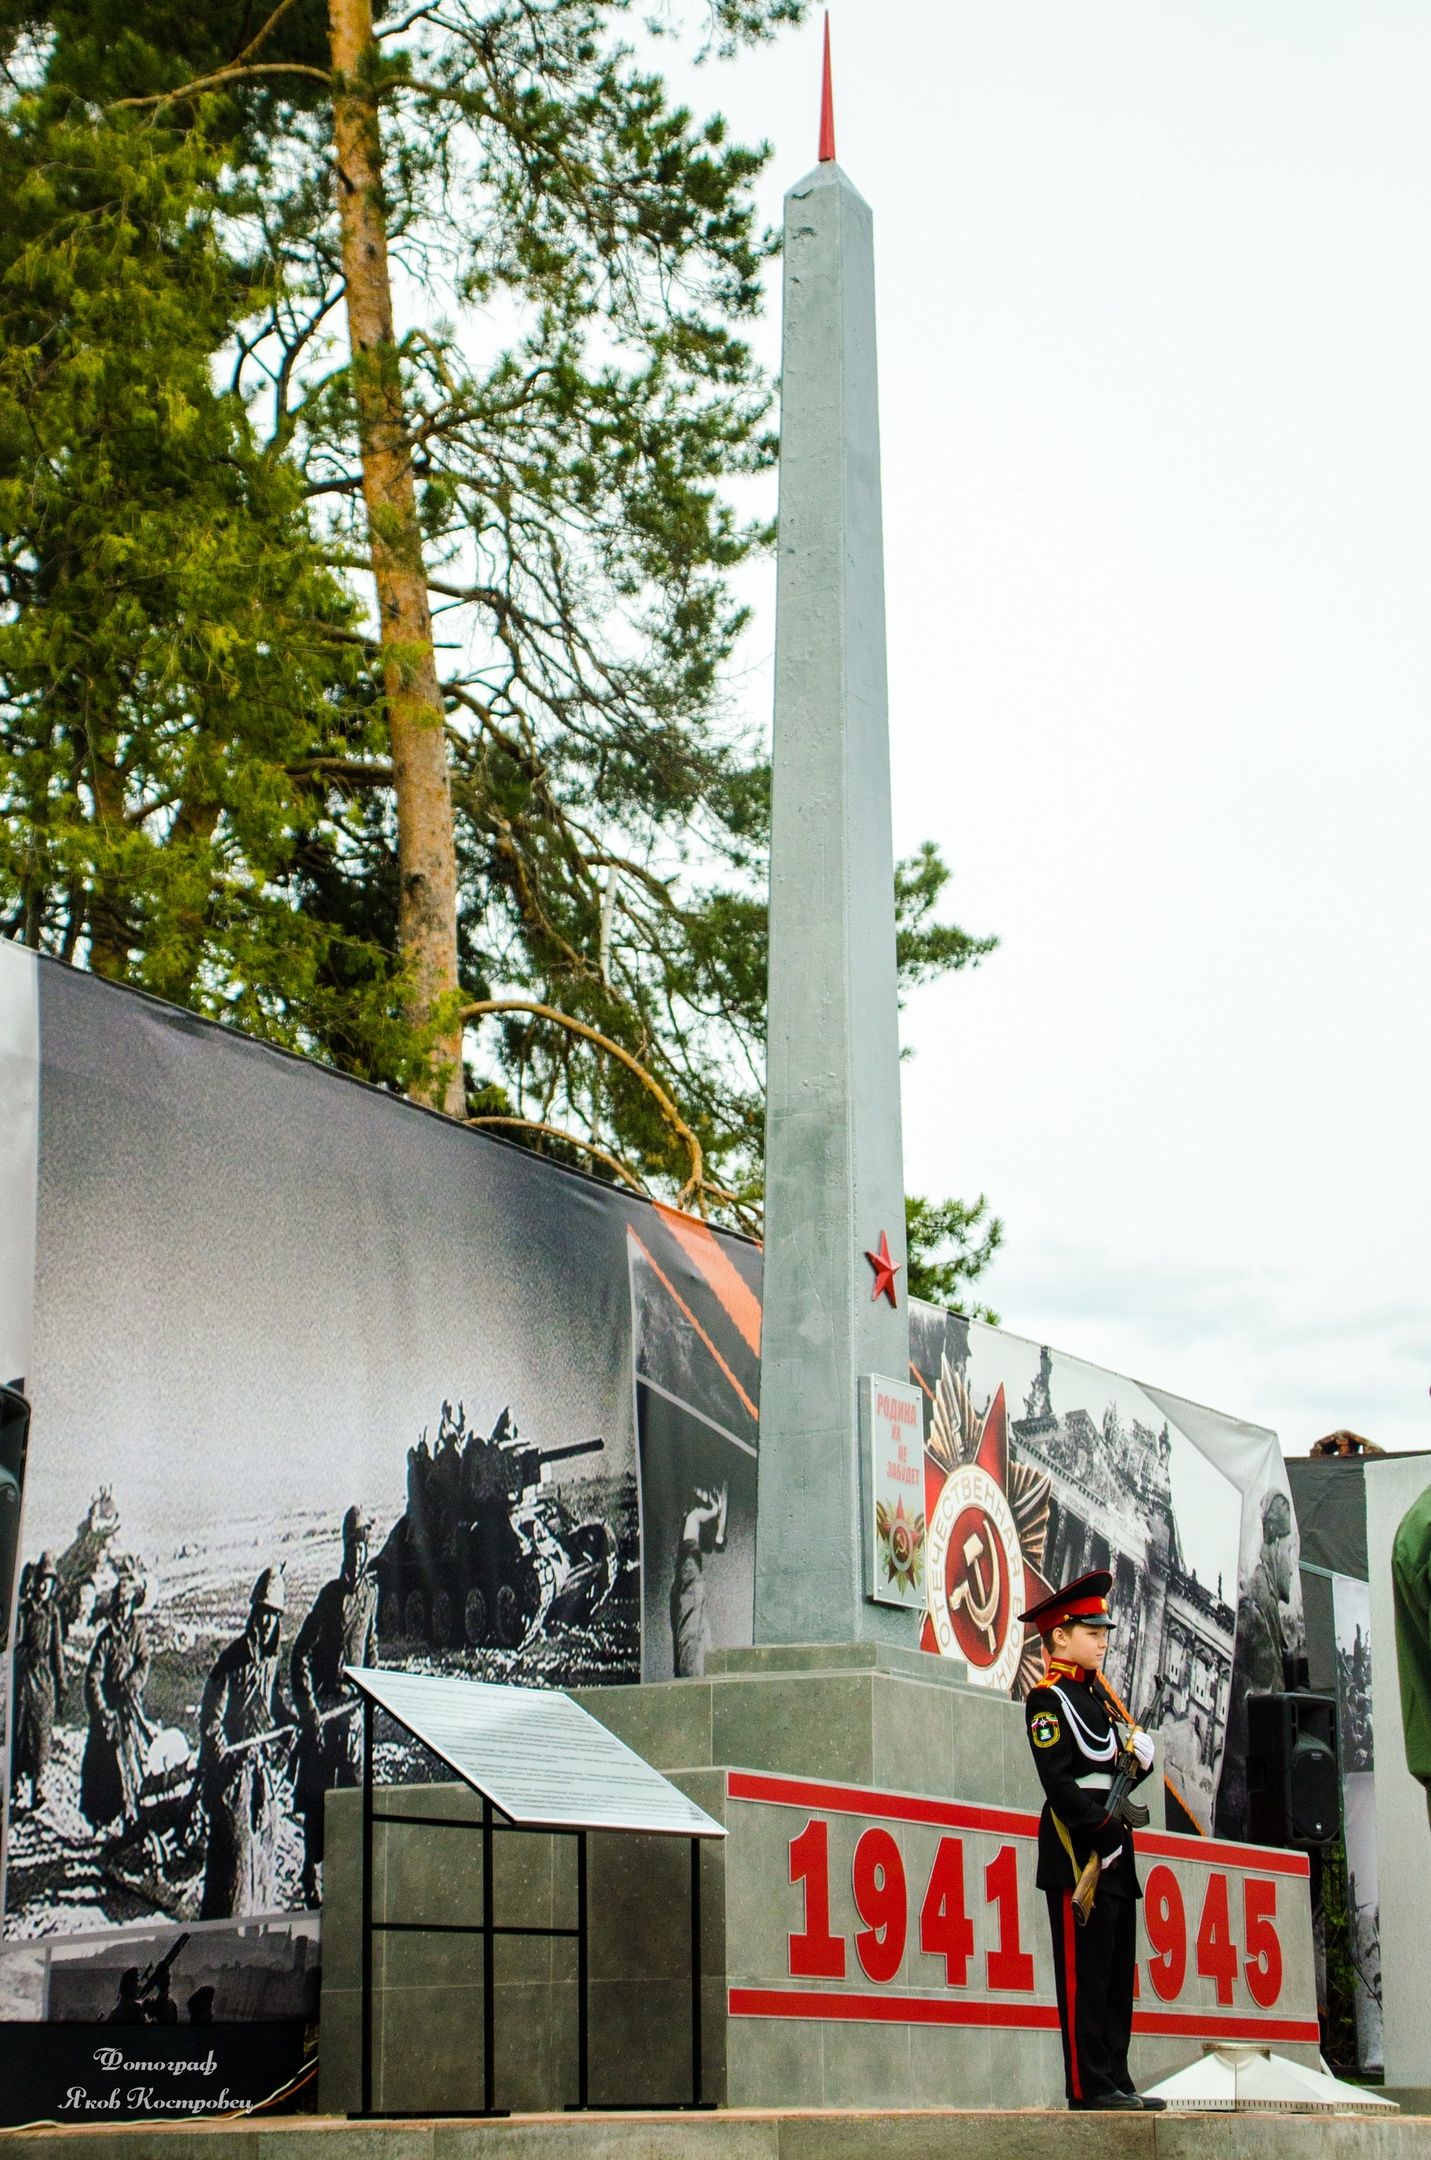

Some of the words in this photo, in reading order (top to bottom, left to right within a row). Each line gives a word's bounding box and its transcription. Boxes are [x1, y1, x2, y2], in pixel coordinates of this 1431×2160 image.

[877, 1393, 917, 1425] РОДИНА
[891, 1423, 901, 1440] ИХ
[898, 1445, 907, 1462] НЕ
[886, 1461, 919, 1486] ЗАБУДЕТ
[932, 1474, 1021, 1648] ОТЕЧЕСТВЕННАЯ
[788, 1818, 1035, 1993] 1941
[1134, 1863, 1283, 2010] 945
